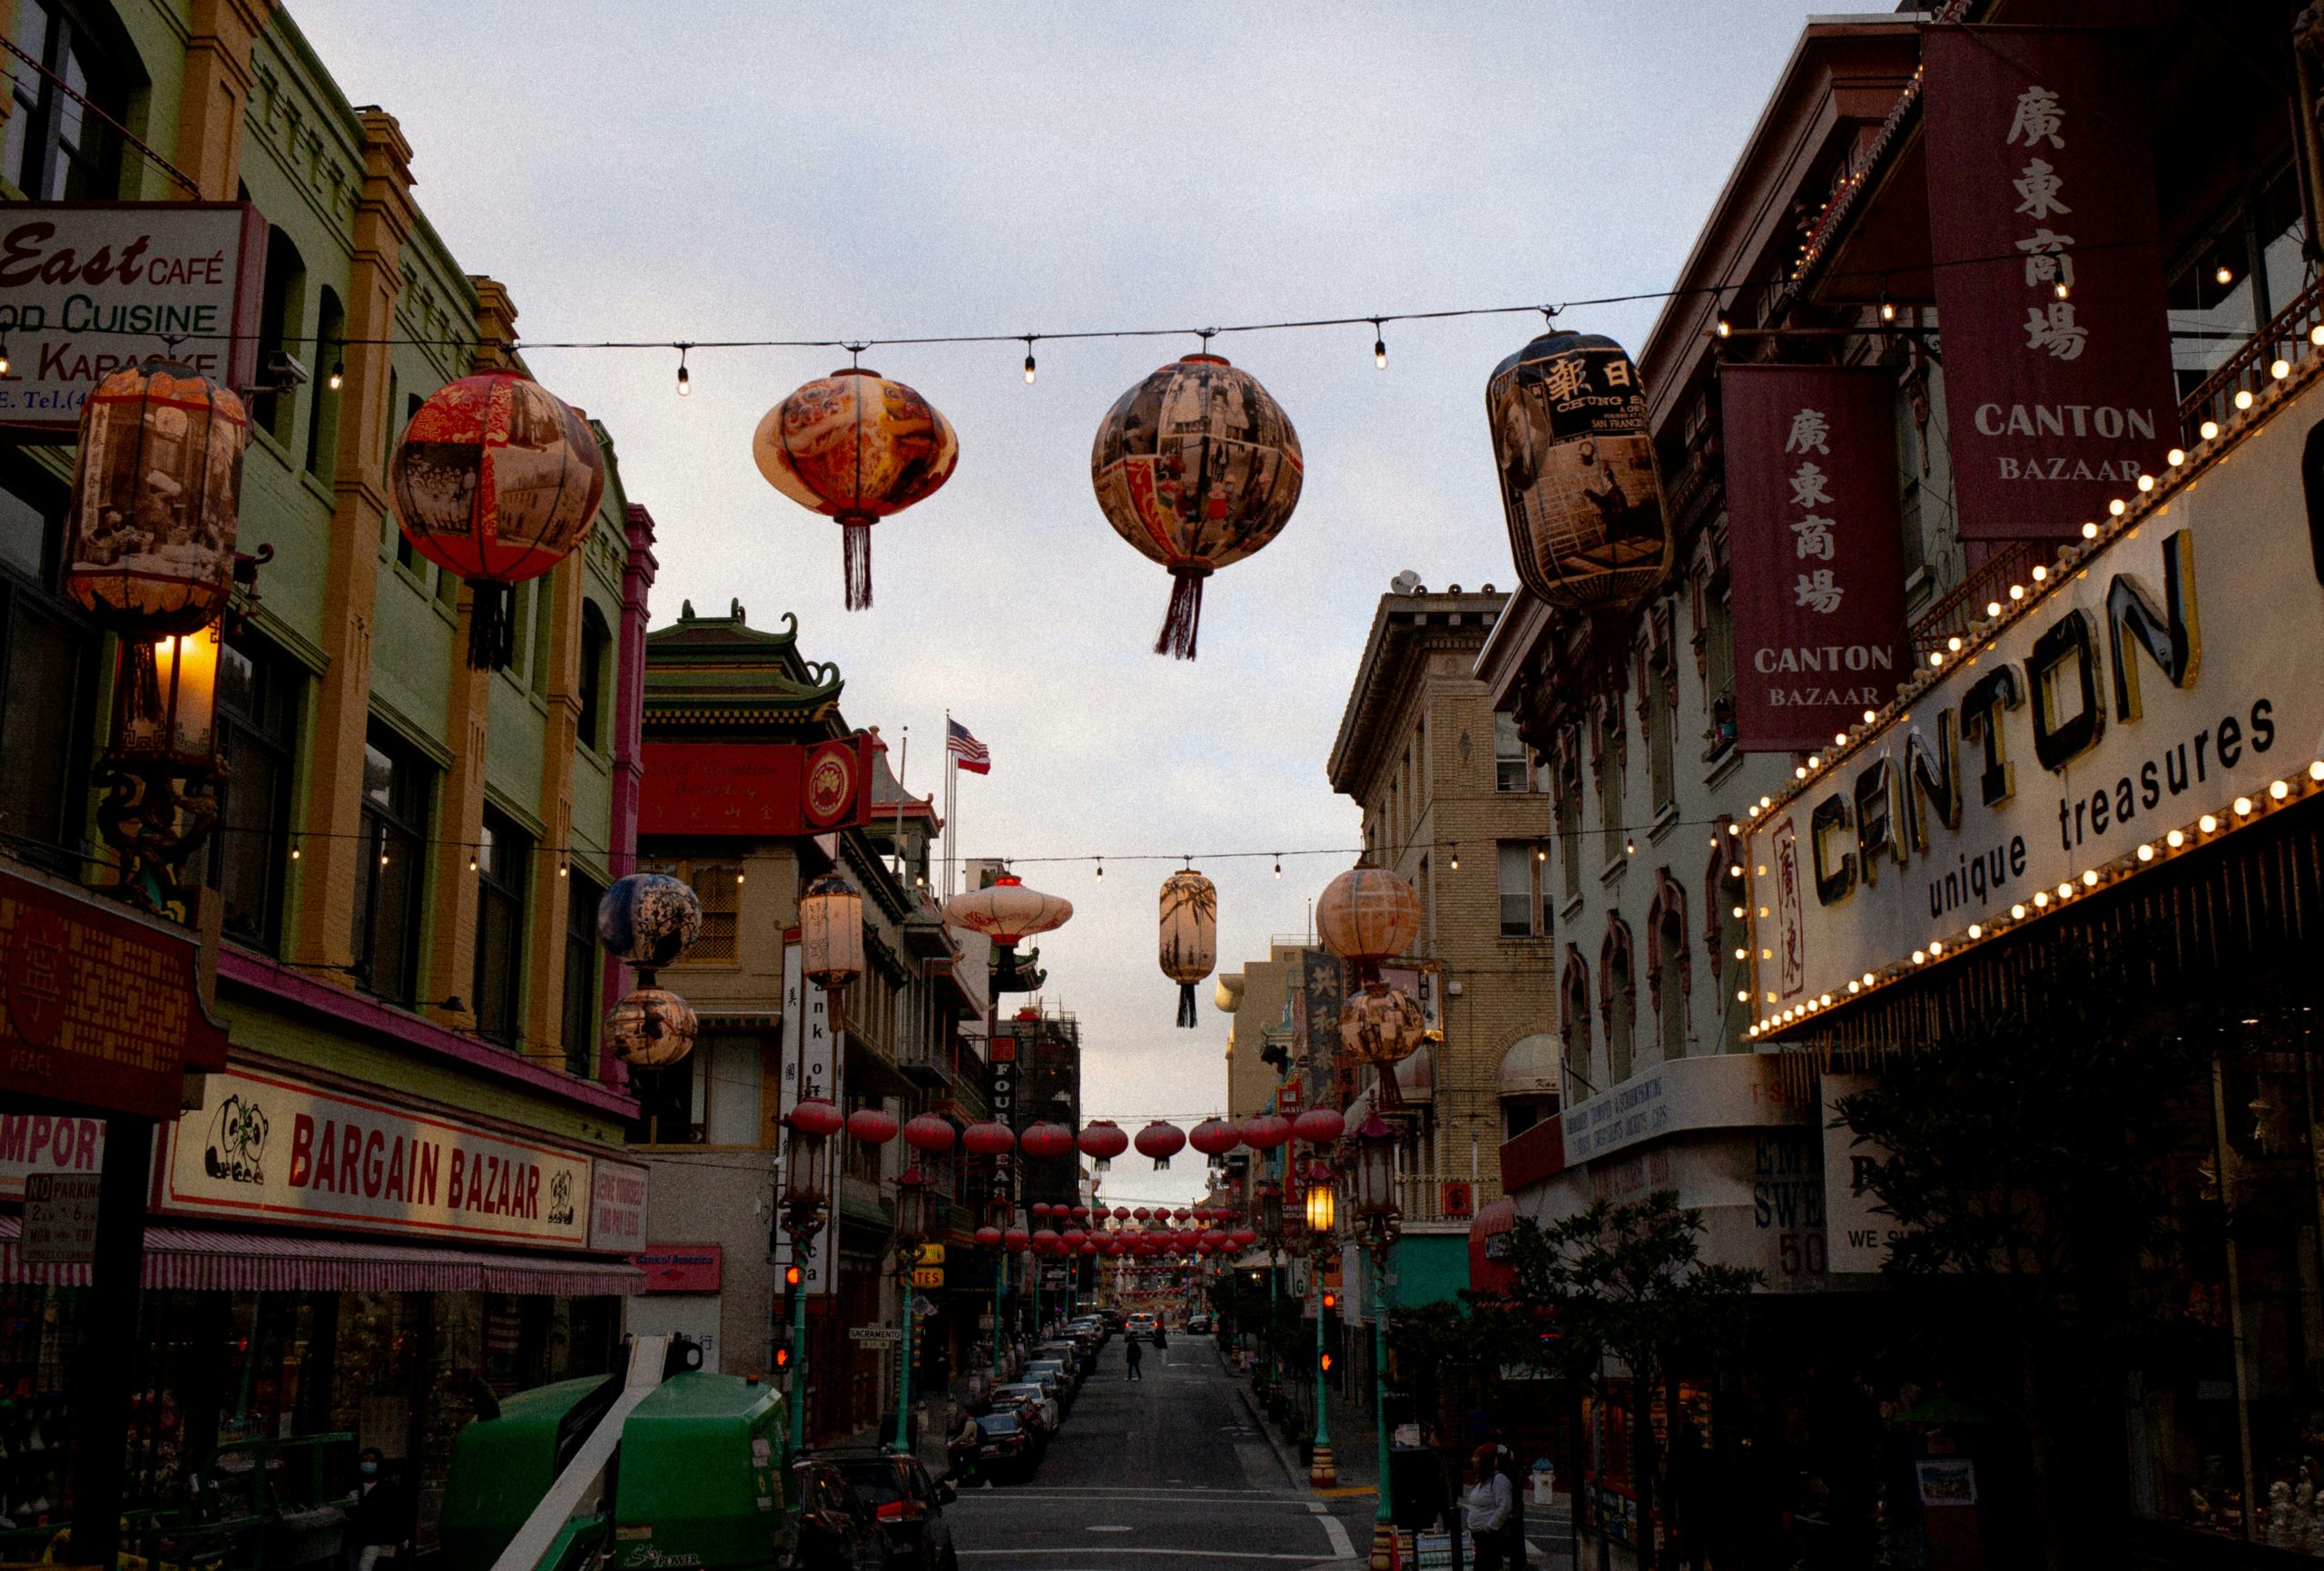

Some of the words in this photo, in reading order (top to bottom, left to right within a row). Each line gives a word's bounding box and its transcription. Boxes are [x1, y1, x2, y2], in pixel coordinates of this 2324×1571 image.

[2006, 85, 2089, 361] 廣東商場
[0, 221, 151, 288] East
[148, 250, 224, 286] CAFÉ
[1974, 403, 2156, 441] CANTON
[1998, 456, 2142, 482] BAZAAR
[1785, 407, 1845, 614] 廣東商場
[1753, 644, 1894, 675] CANTON
[1769, 686, 1880, 708] BAZAAR
[1811, 528, 2201, 908] CANTON
[1929, 834, 2027, 918] unique
[2059, 698, 2276, 851] treasures
[10, 1047, 54, 1077] PEACE
[288, 1113, 440, 1206] BARGAIN
[448, 1148, 540, 1221] BAZAAR
[29, 1177, 51, 1199] NO
[851, 1328, 901, 1340] SACRAMENTO
